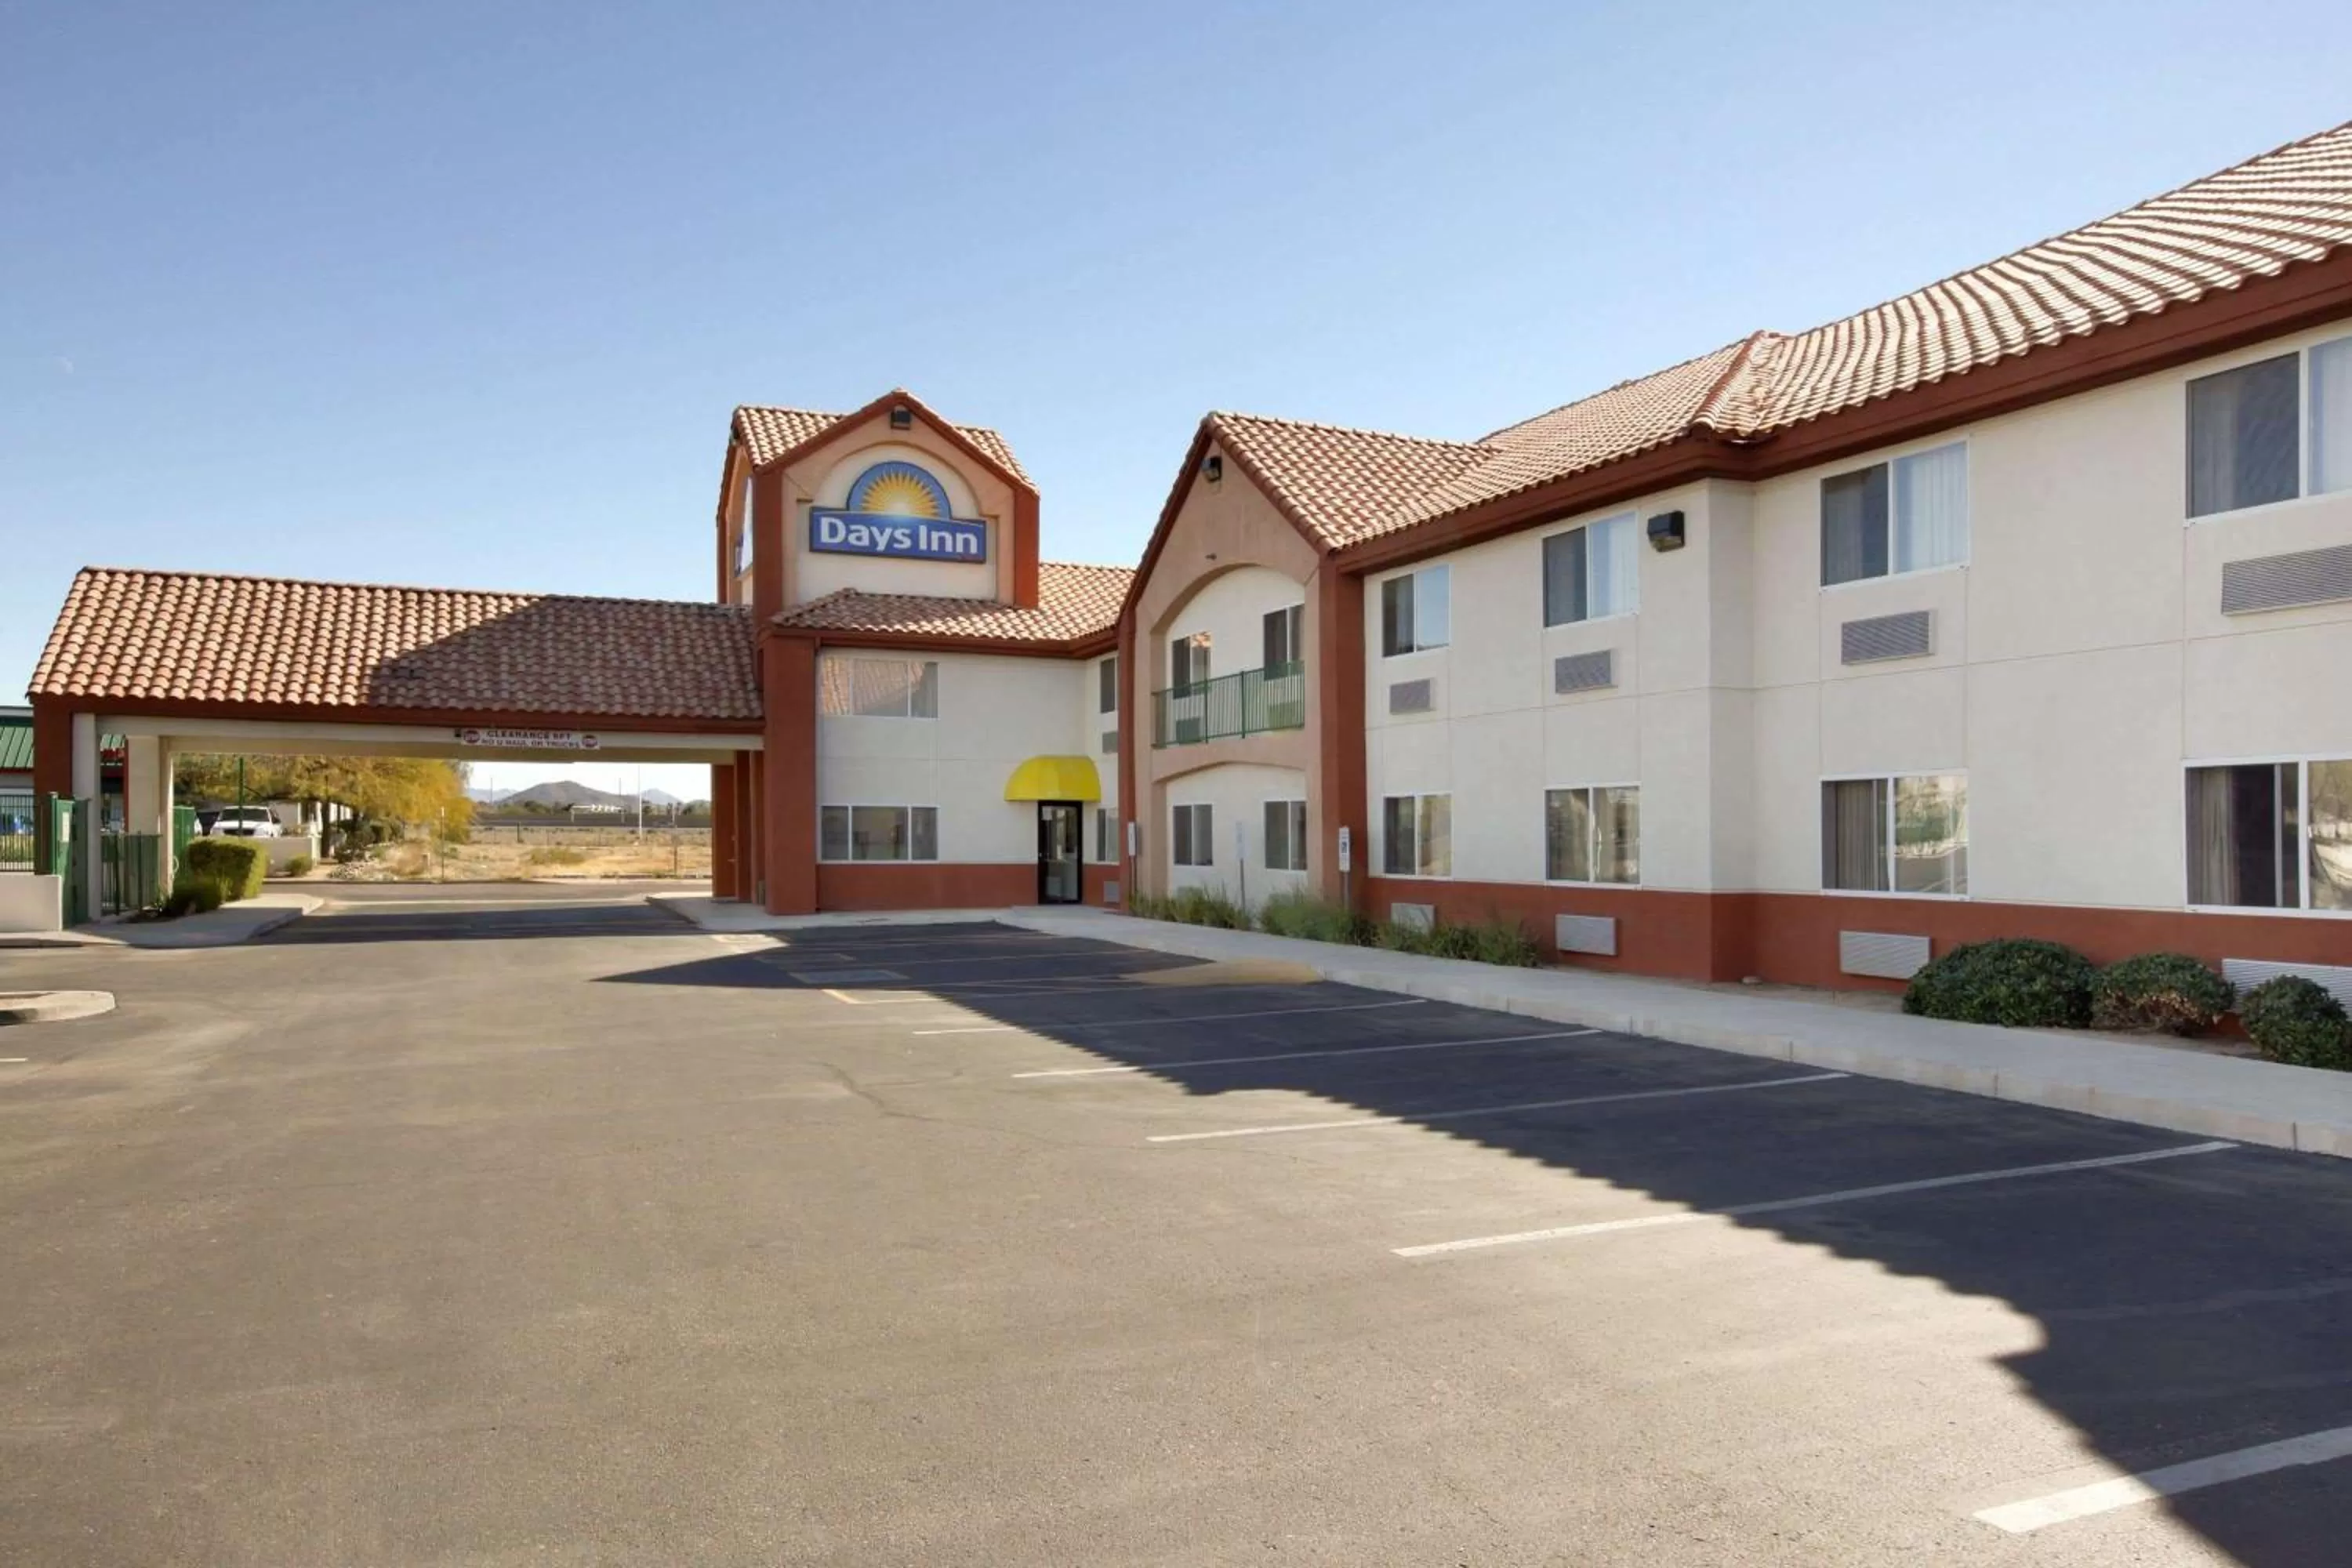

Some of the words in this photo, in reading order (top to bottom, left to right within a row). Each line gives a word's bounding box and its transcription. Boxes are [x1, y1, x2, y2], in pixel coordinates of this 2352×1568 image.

[820, 517, 912, 552] Days
[919, 524, 978, 554] Inn
[487, 730, 550, 739] CLEARANCE
